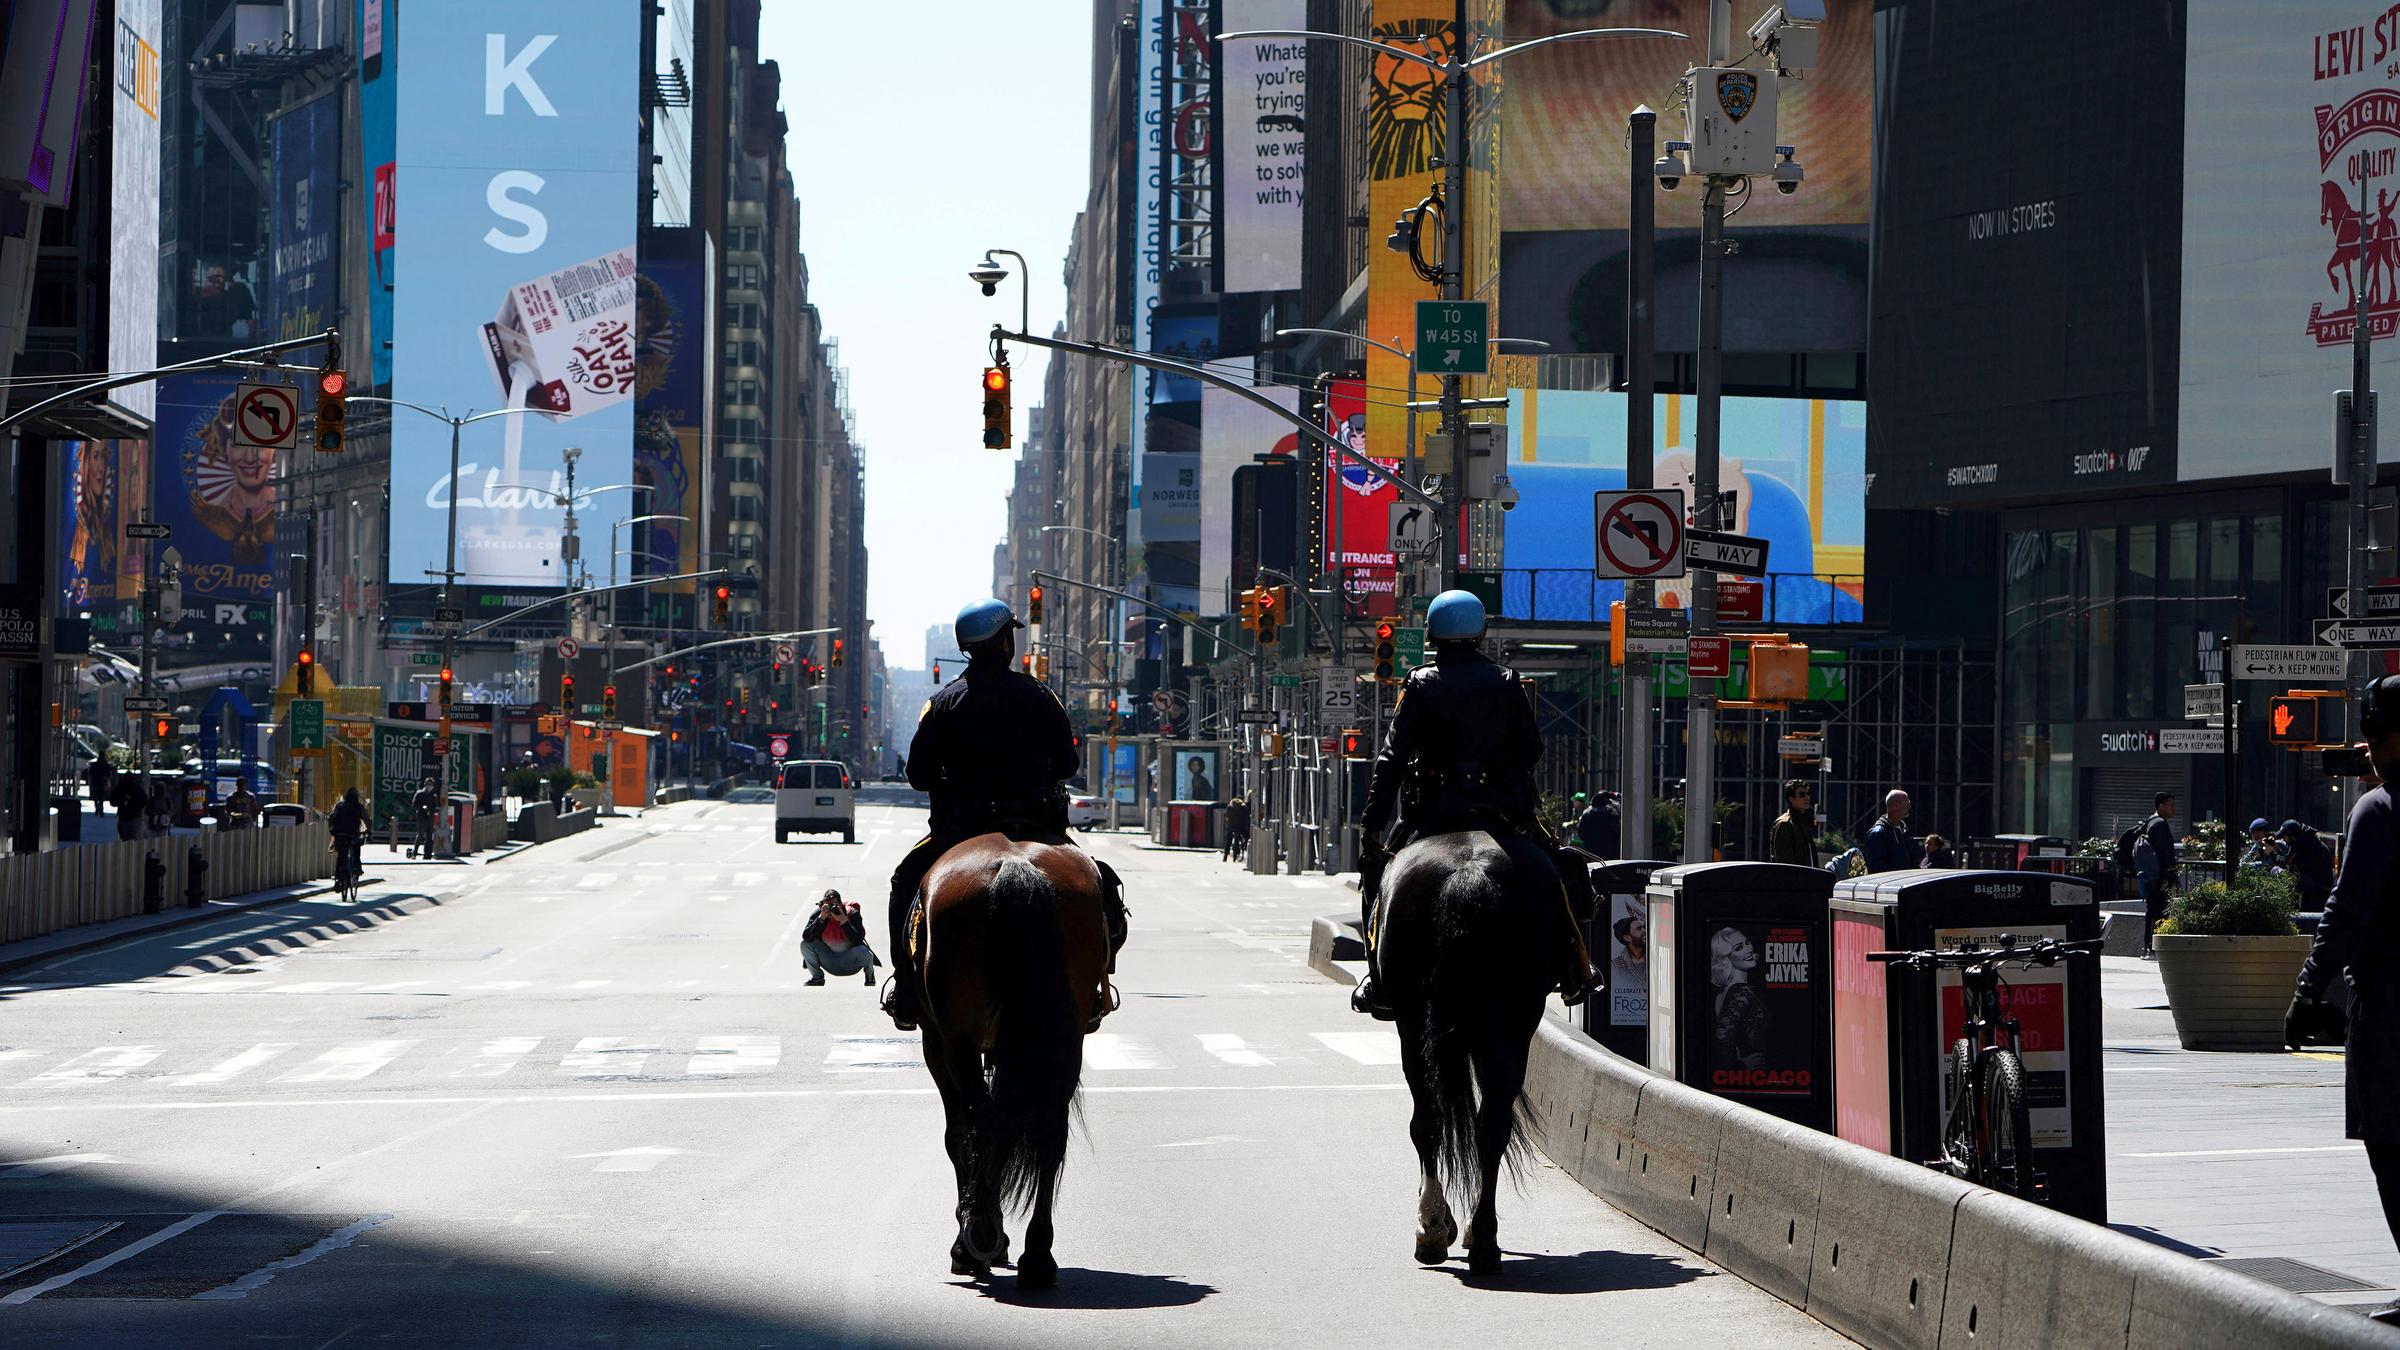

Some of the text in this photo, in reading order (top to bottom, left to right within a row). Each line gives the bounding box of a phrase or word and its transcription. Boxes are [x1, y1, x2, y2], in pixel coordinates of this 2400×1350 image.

[2314, 26, 2364, 81] LEVI
[1256, 68, 1305, 91] you're
[1257, 92, 1304, 115] trying
[1257, 142, 1279, 156] we
[1257, 164, 1273, 181] to
[1257, 187, 1292, 205] with
[1969, 201, 2056, 241] NOW IN STORES
[275, 232, 328, 277] NORWEGIAN
[1443, 310, 1462, 324] TO
[1427, 330, 1478, 344] W 45 St
[566, 358, 590, 384] Silk
[573, 346, 614, 389] OAT
[2074, 449, 2108, 474] swatch
[1947, 464, 1998, 486] #SWATCHX007
[1153, 490, 1200, 502] NORWEG
[1395, 539, 1424, 550] ONLY
[1717, 548, 1752, 564] WAY
[1344, 580, 1394, 592] OADWAY
[1722, 586, 1750, 594] STANDING
[1716, 595, 1736, 603] nytime
[2373, 595, 2395, 608] WAY
[0, 609, 22, 620] U.S.
[180, 608, 206, 619] PRIL
[215, 604, 248, 625] FX
[250, 611, 266, 621] ON
[0, 620, 34, 631] POLO
[1629, 619, 1677, 629] Times Square
[0, 632, 37, 643] ASSN.
[1629, 629, 1684, 637] Pedestrian Plaza
[2329, 628, 2396, 642] ONE WAY
[1690, 641, 1720, 651] NO STANDING
[1690, 650, 1709, 658] Anytime
[2245, 650, 2340, 662] PEDESTRIAN FLOW ZONE
[2288, 664, 2340, 675] KEEP MOVING
[1326, 691, 1352, 706] 25
[297, 727, 317, 735] South
[2163, 732, 2225, 742] PEDESTRIAN FLOW ZON
[2101, 730, 2147, 752] swatch
[2190, 742, 2225, 750] KEEP MOVIN
[1974, 884, 2023, 896] BigBelly
[1941, 934, 2045, 945] Word on th Street
[1765, 942, 1808, 963] ERIKA
[1765, 963, 1808, 983] JAYNE
[1713, 1070, 1812, 1087] CHICAGO
